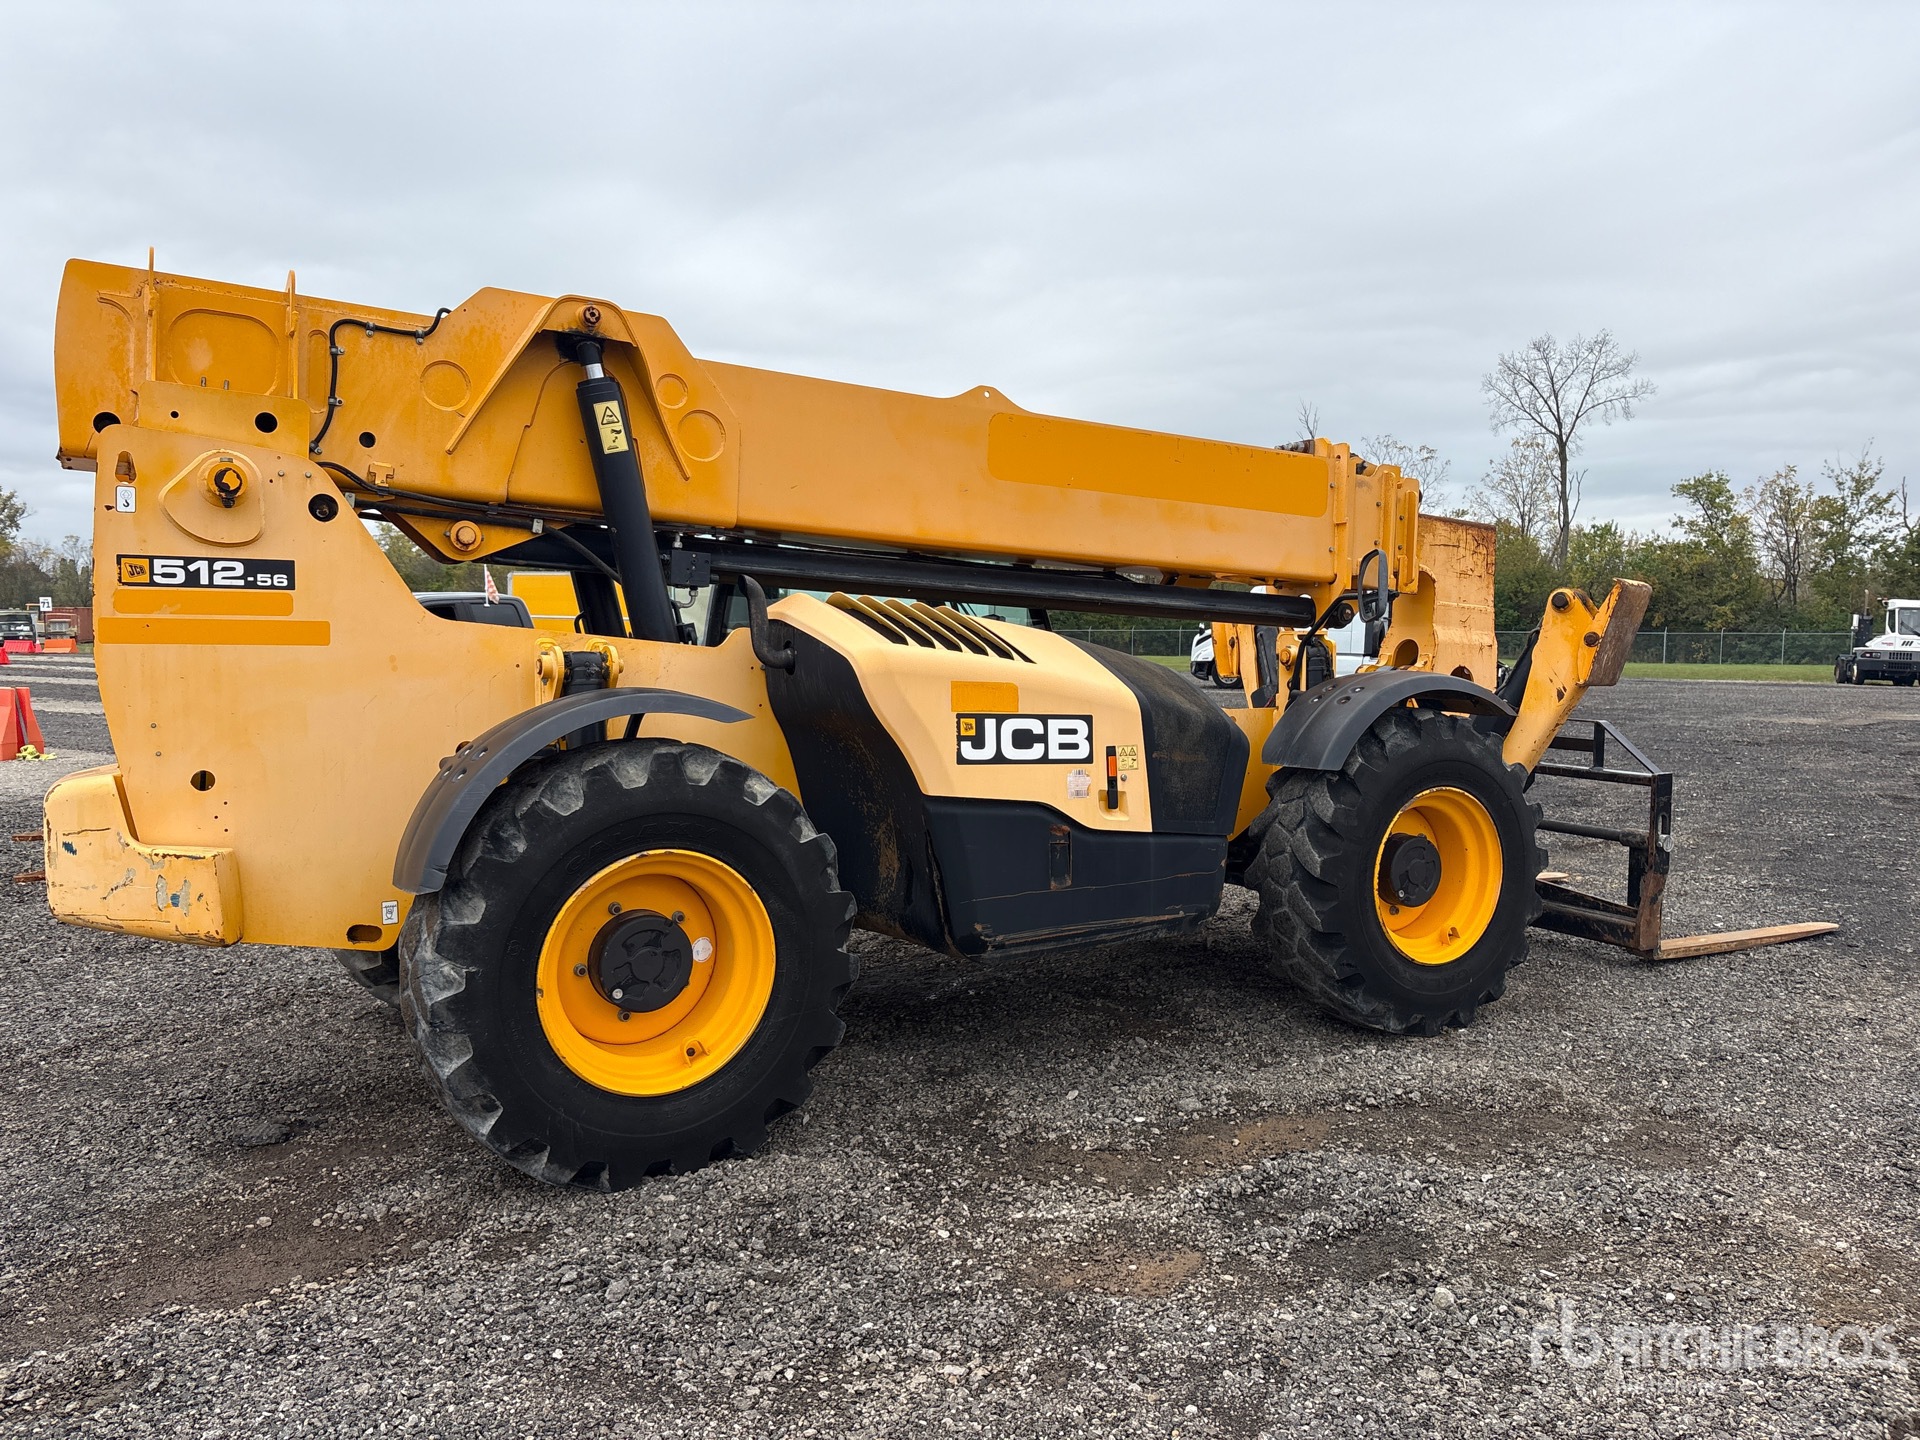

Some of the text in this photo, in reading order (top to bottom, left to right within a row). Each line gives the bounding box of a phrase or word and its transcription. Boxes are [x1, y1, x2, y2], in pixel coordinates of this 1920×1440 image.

[126, 563, 146, 577] JCB
[40, 601, 51, 609] 71
[960, 718, 1090, 761] JCB
[565, 821, 718, 875] GALAXY
